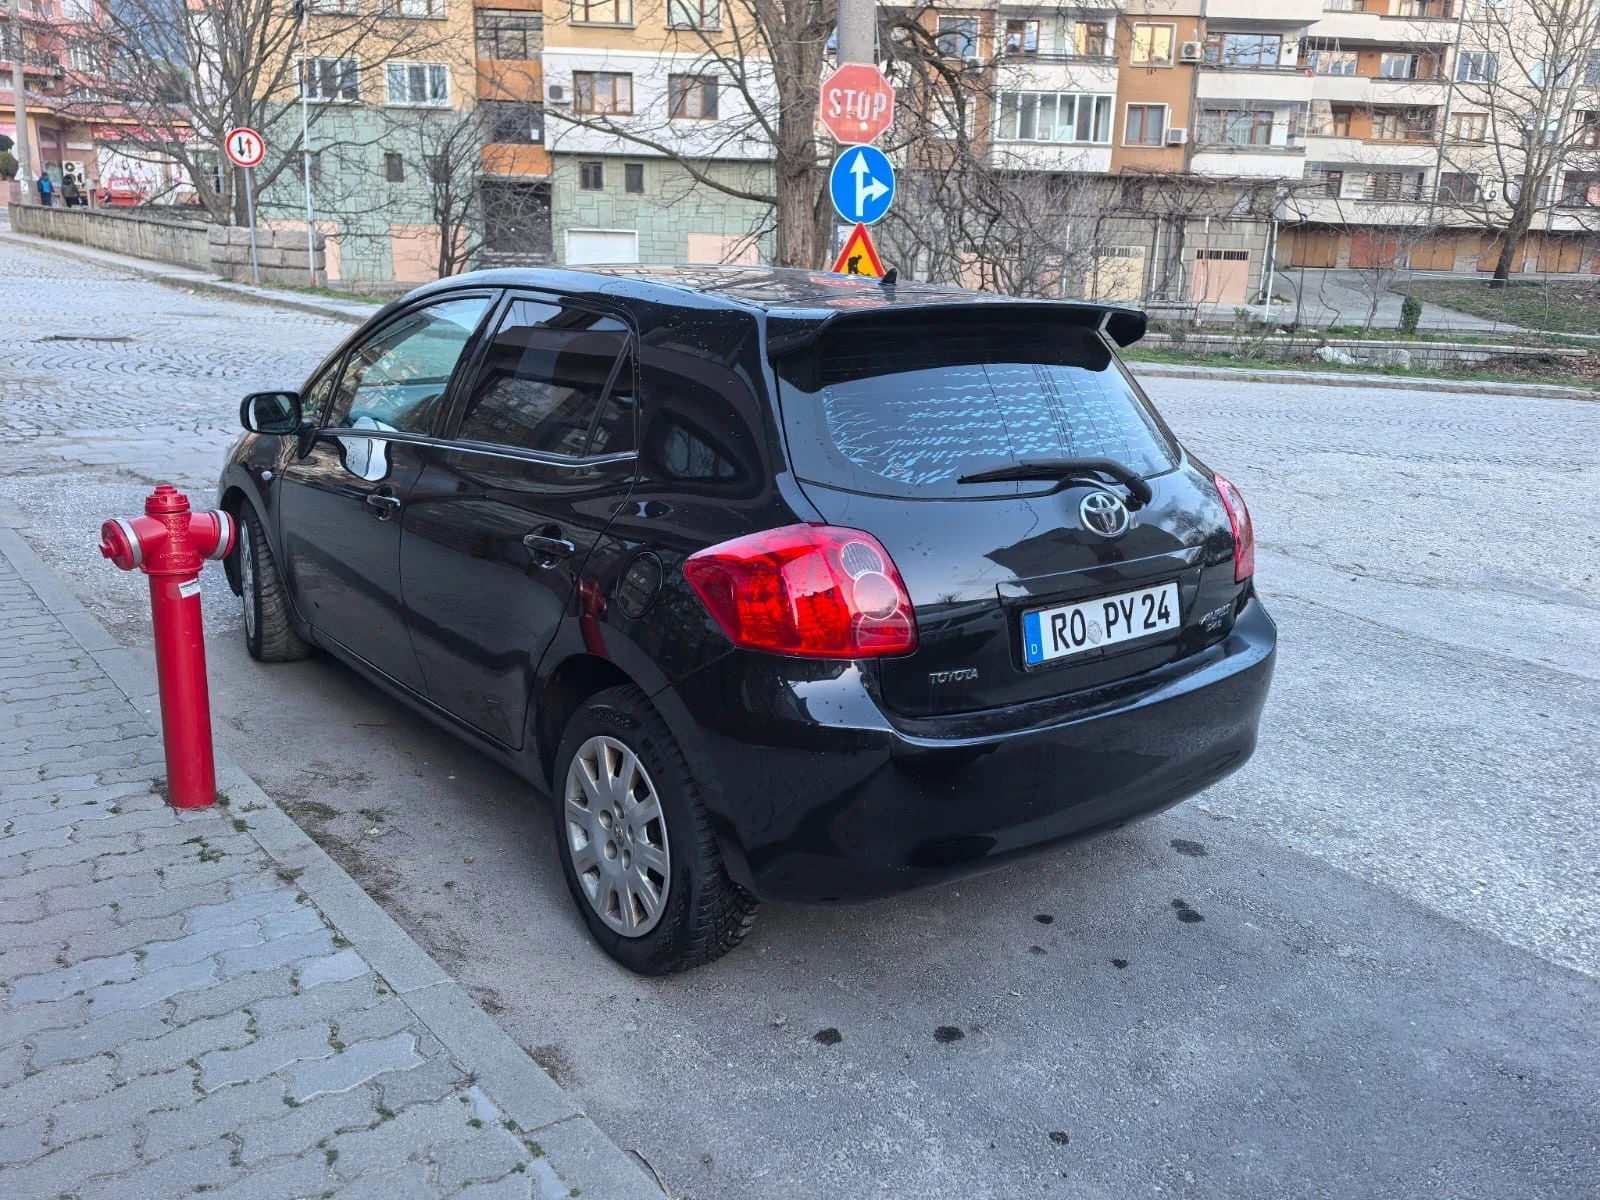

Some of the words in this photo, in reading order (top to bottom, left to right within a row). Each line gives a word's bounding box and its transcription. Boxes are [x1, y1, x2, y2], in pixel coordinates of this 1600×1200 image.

[828, 87, 887, 121] STOP
[1051, 608, 1087, 652] RO
[1102, 597, 1135, 639] PY
[1141, 589, 1171, 630] 24
[1031, 643, 1038, 655] D
[929, 668, 978, 685] TOYOTA
